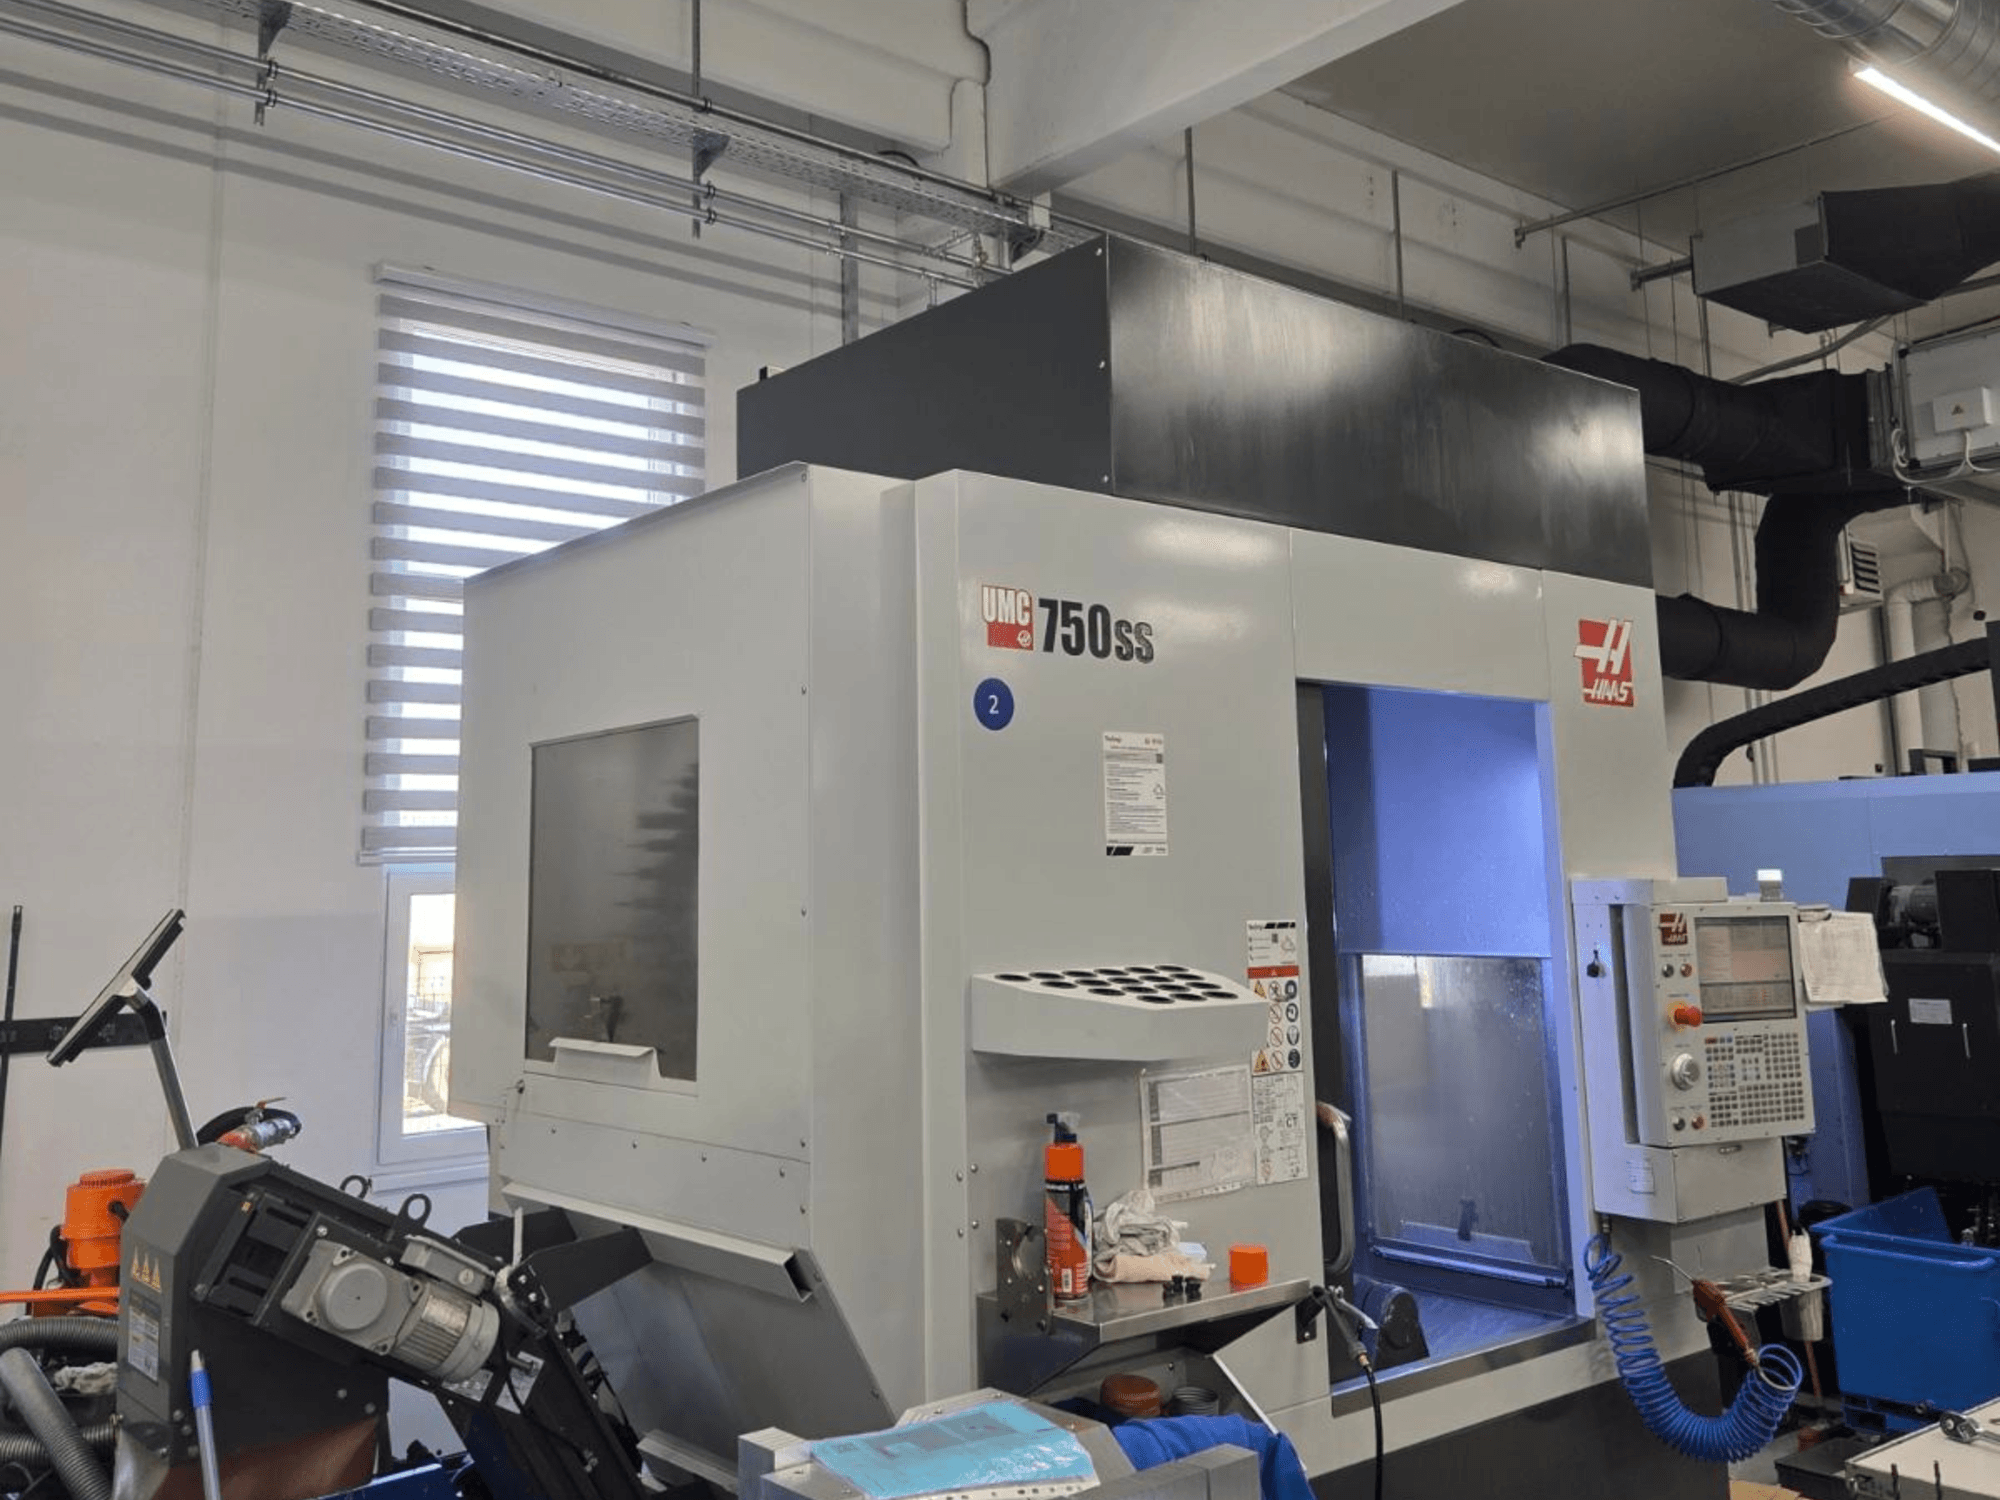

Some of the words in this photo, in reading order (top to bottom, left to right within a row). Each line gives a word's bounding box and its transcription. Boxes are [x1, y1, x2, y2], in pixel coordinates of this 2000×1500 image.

[981, 585, 1032, 626] UMC
[1583, 678, 1634, 702] HAAS
[988, 694, 1000, 715] 2
